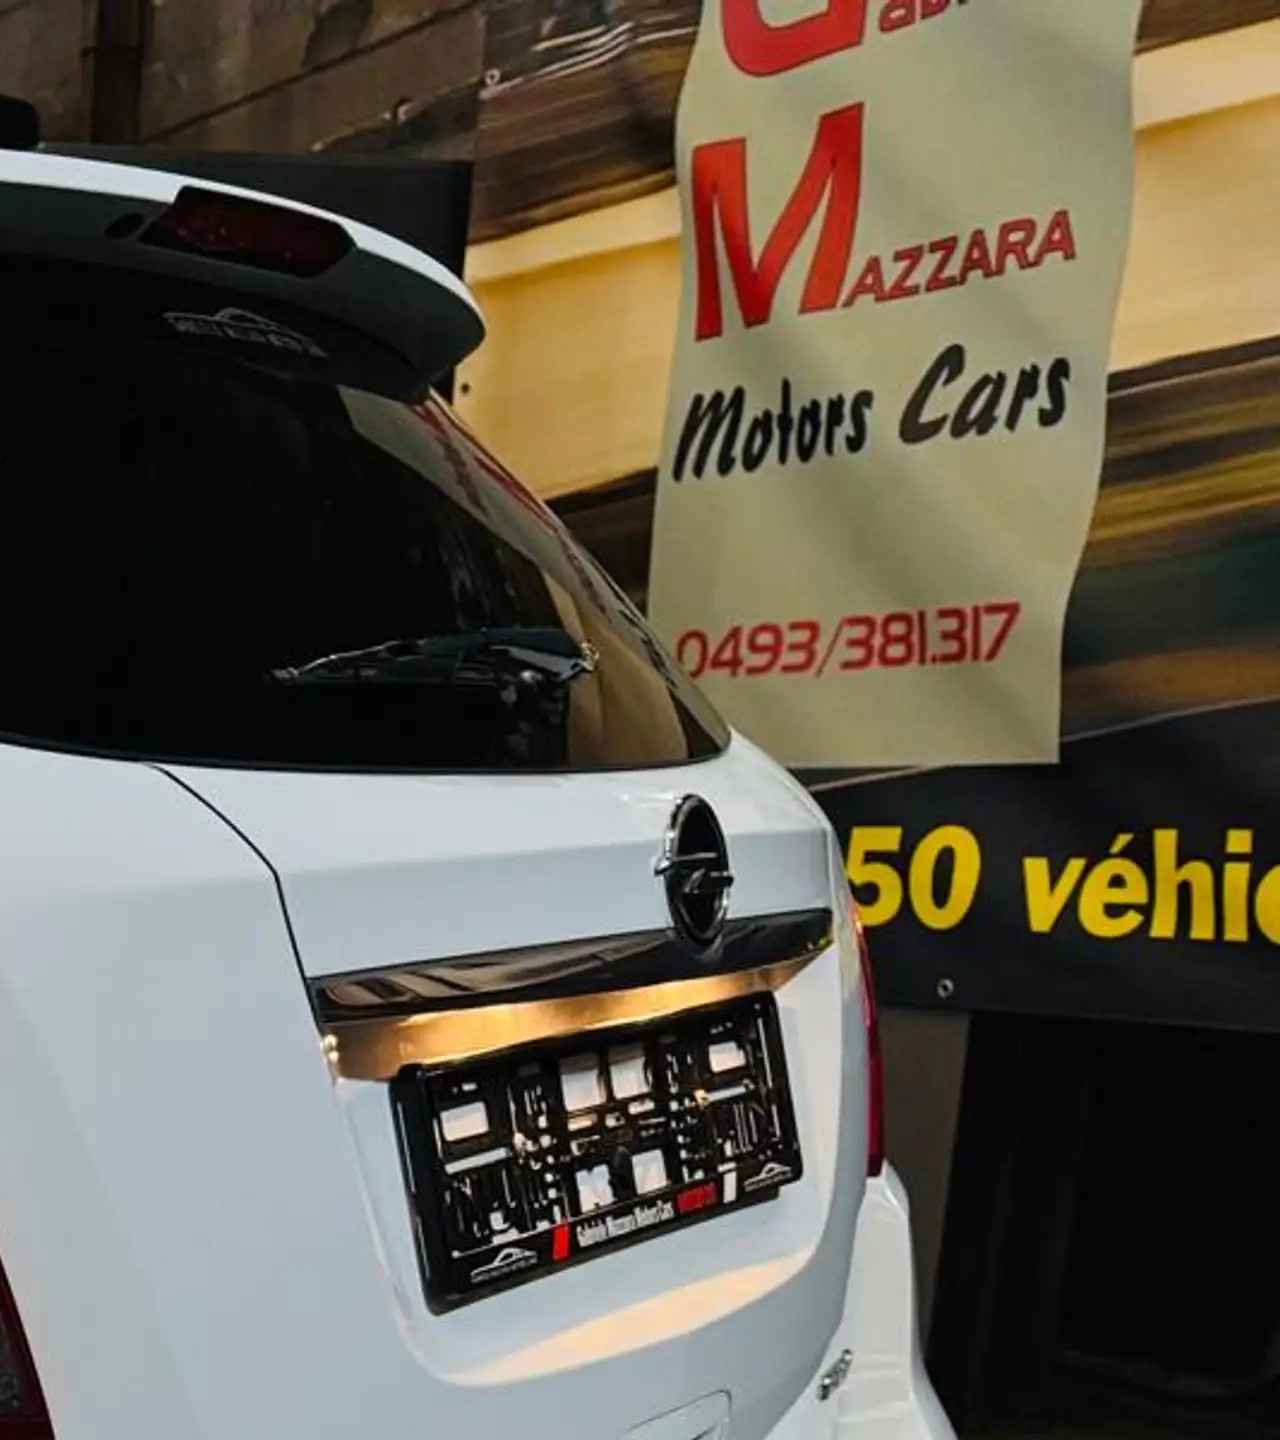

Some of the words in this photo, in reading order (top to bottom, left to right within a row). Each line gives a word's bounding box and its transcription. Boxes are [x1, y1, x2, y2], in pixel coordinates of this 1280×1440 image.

[691, 103, 1077, 341] MAZZARA
[672, 377, 874, 482] Motors
[899, 343, 1072, 444] Cars
